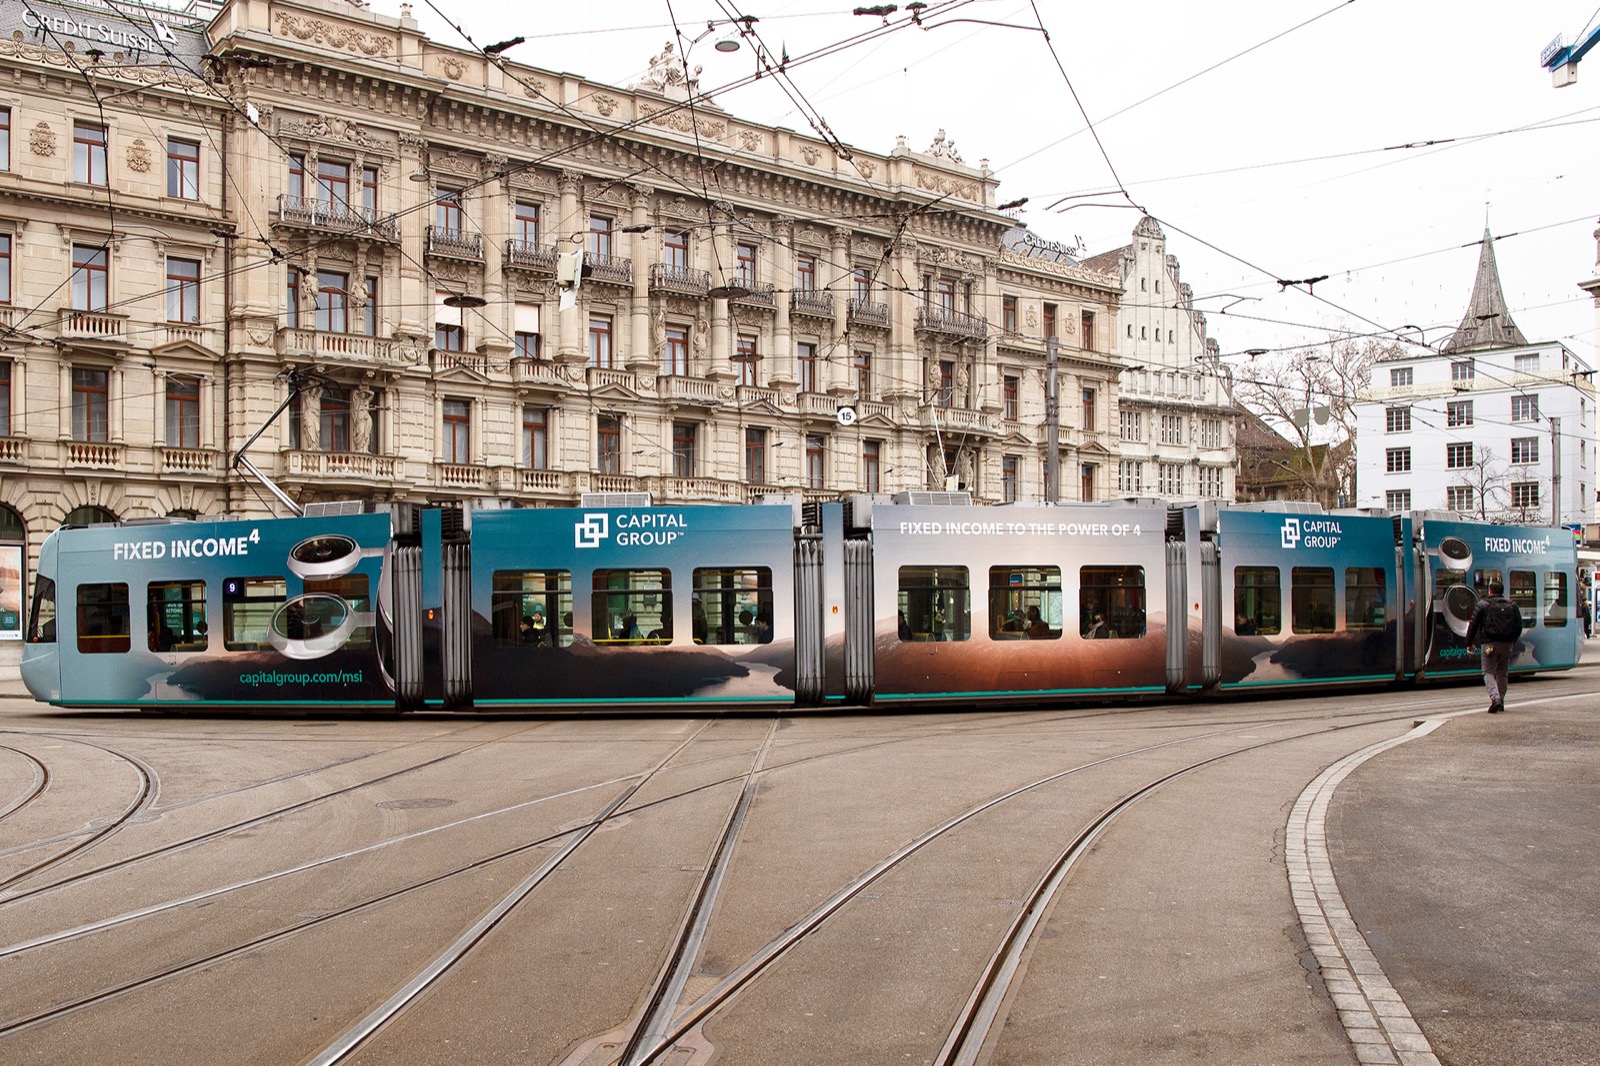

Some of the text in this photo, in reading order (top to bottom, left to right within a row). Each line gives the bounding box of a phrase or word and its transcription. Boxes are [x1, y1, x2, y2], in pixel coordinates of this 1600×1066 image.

[22, 9, 157, 52] CREDIT SUISSE
[841, 411, 851, 420] 15
[616, 514, 687, 528] CAPITAL
[1303, 520, 1342, 533] CAPITAL
[900, 522, 1142, 536] FIXED INCOME TO THE POWER OF 4
[113, 541, 166, 560] FIXED
[1484, 537, 1511, 553] FIXED
[229, 583, 236, 593] 9
[239, 669, 363, 687] capitalgroup.com/msi
